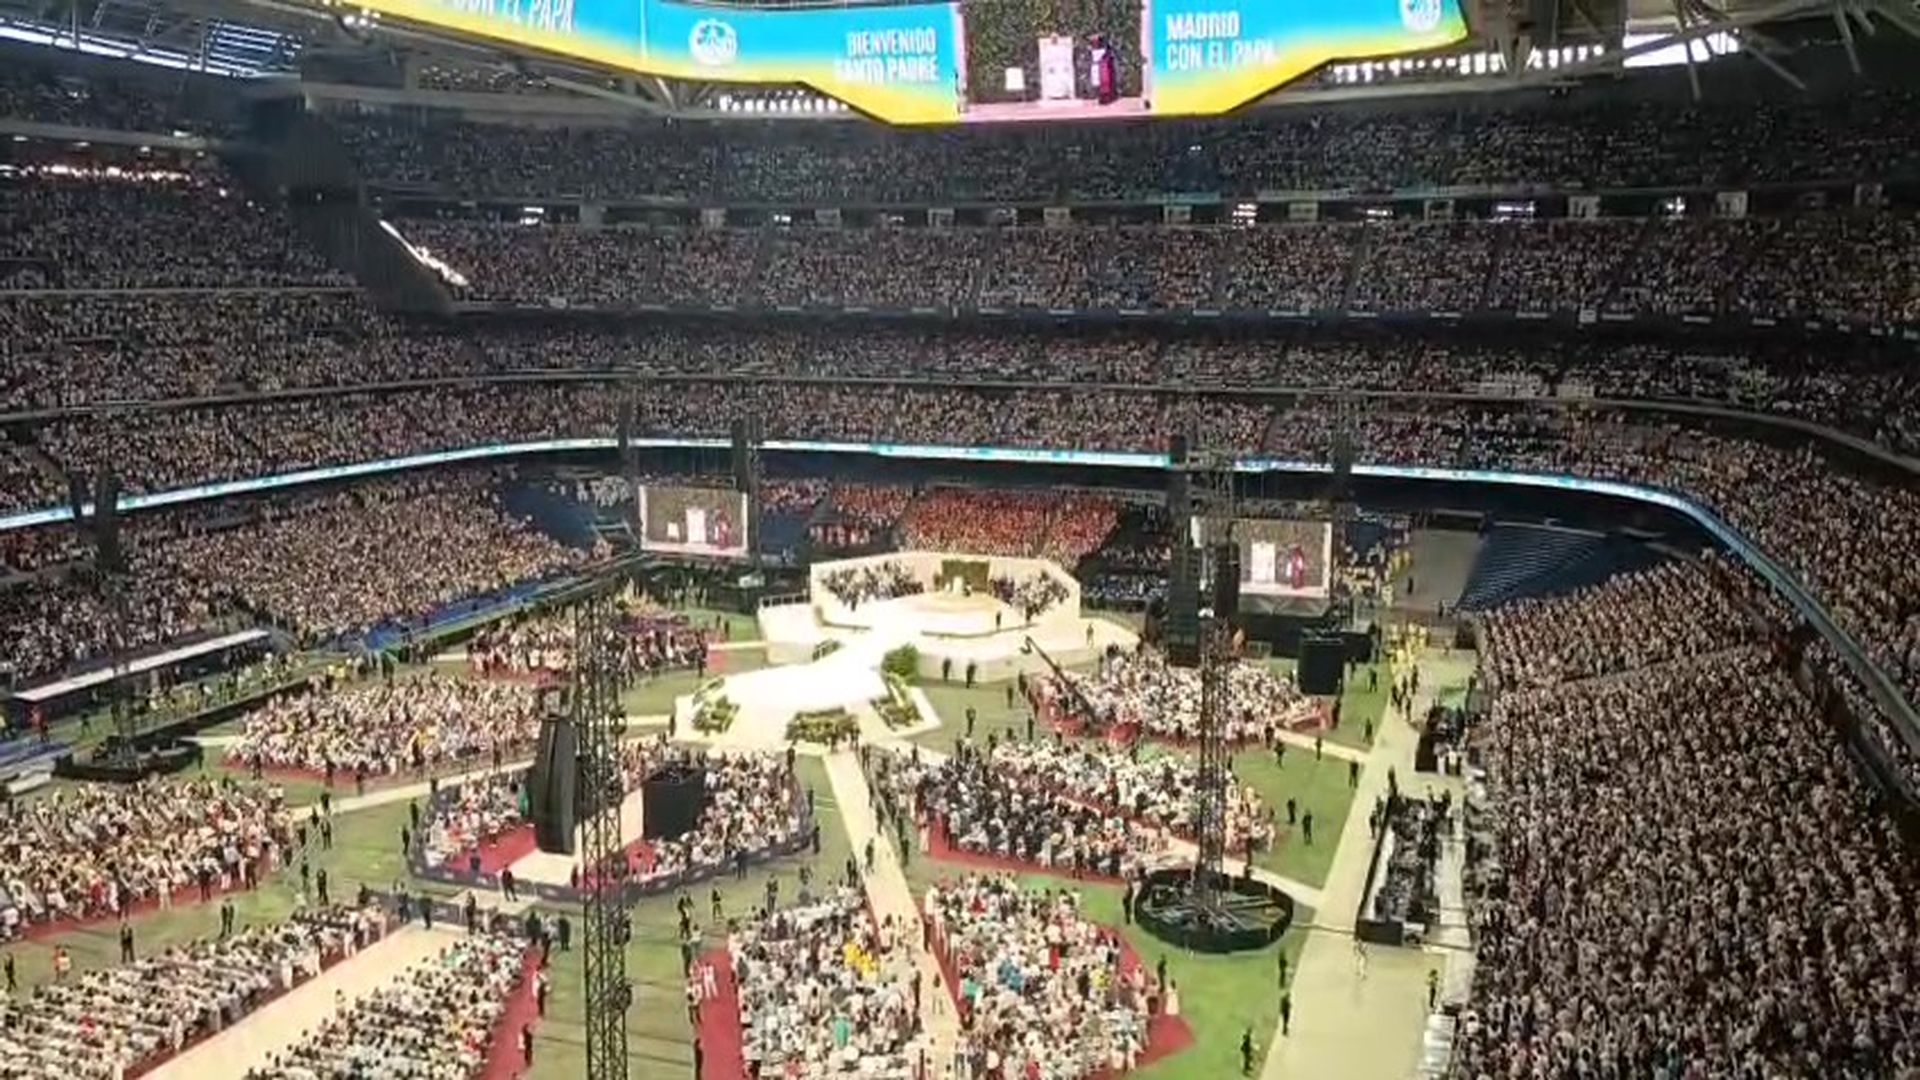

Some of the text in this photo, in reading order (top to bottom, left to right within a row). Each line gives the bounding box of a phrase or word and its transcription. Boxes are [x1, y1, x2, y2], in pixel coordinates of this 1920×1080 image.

[1166, 10, 1240, 40] MADRID
[846, 27, 937, 57] BIENVENIDO
[1167, 41, 1203, 70] CON
[1208, 40, 1229, 69] EL
